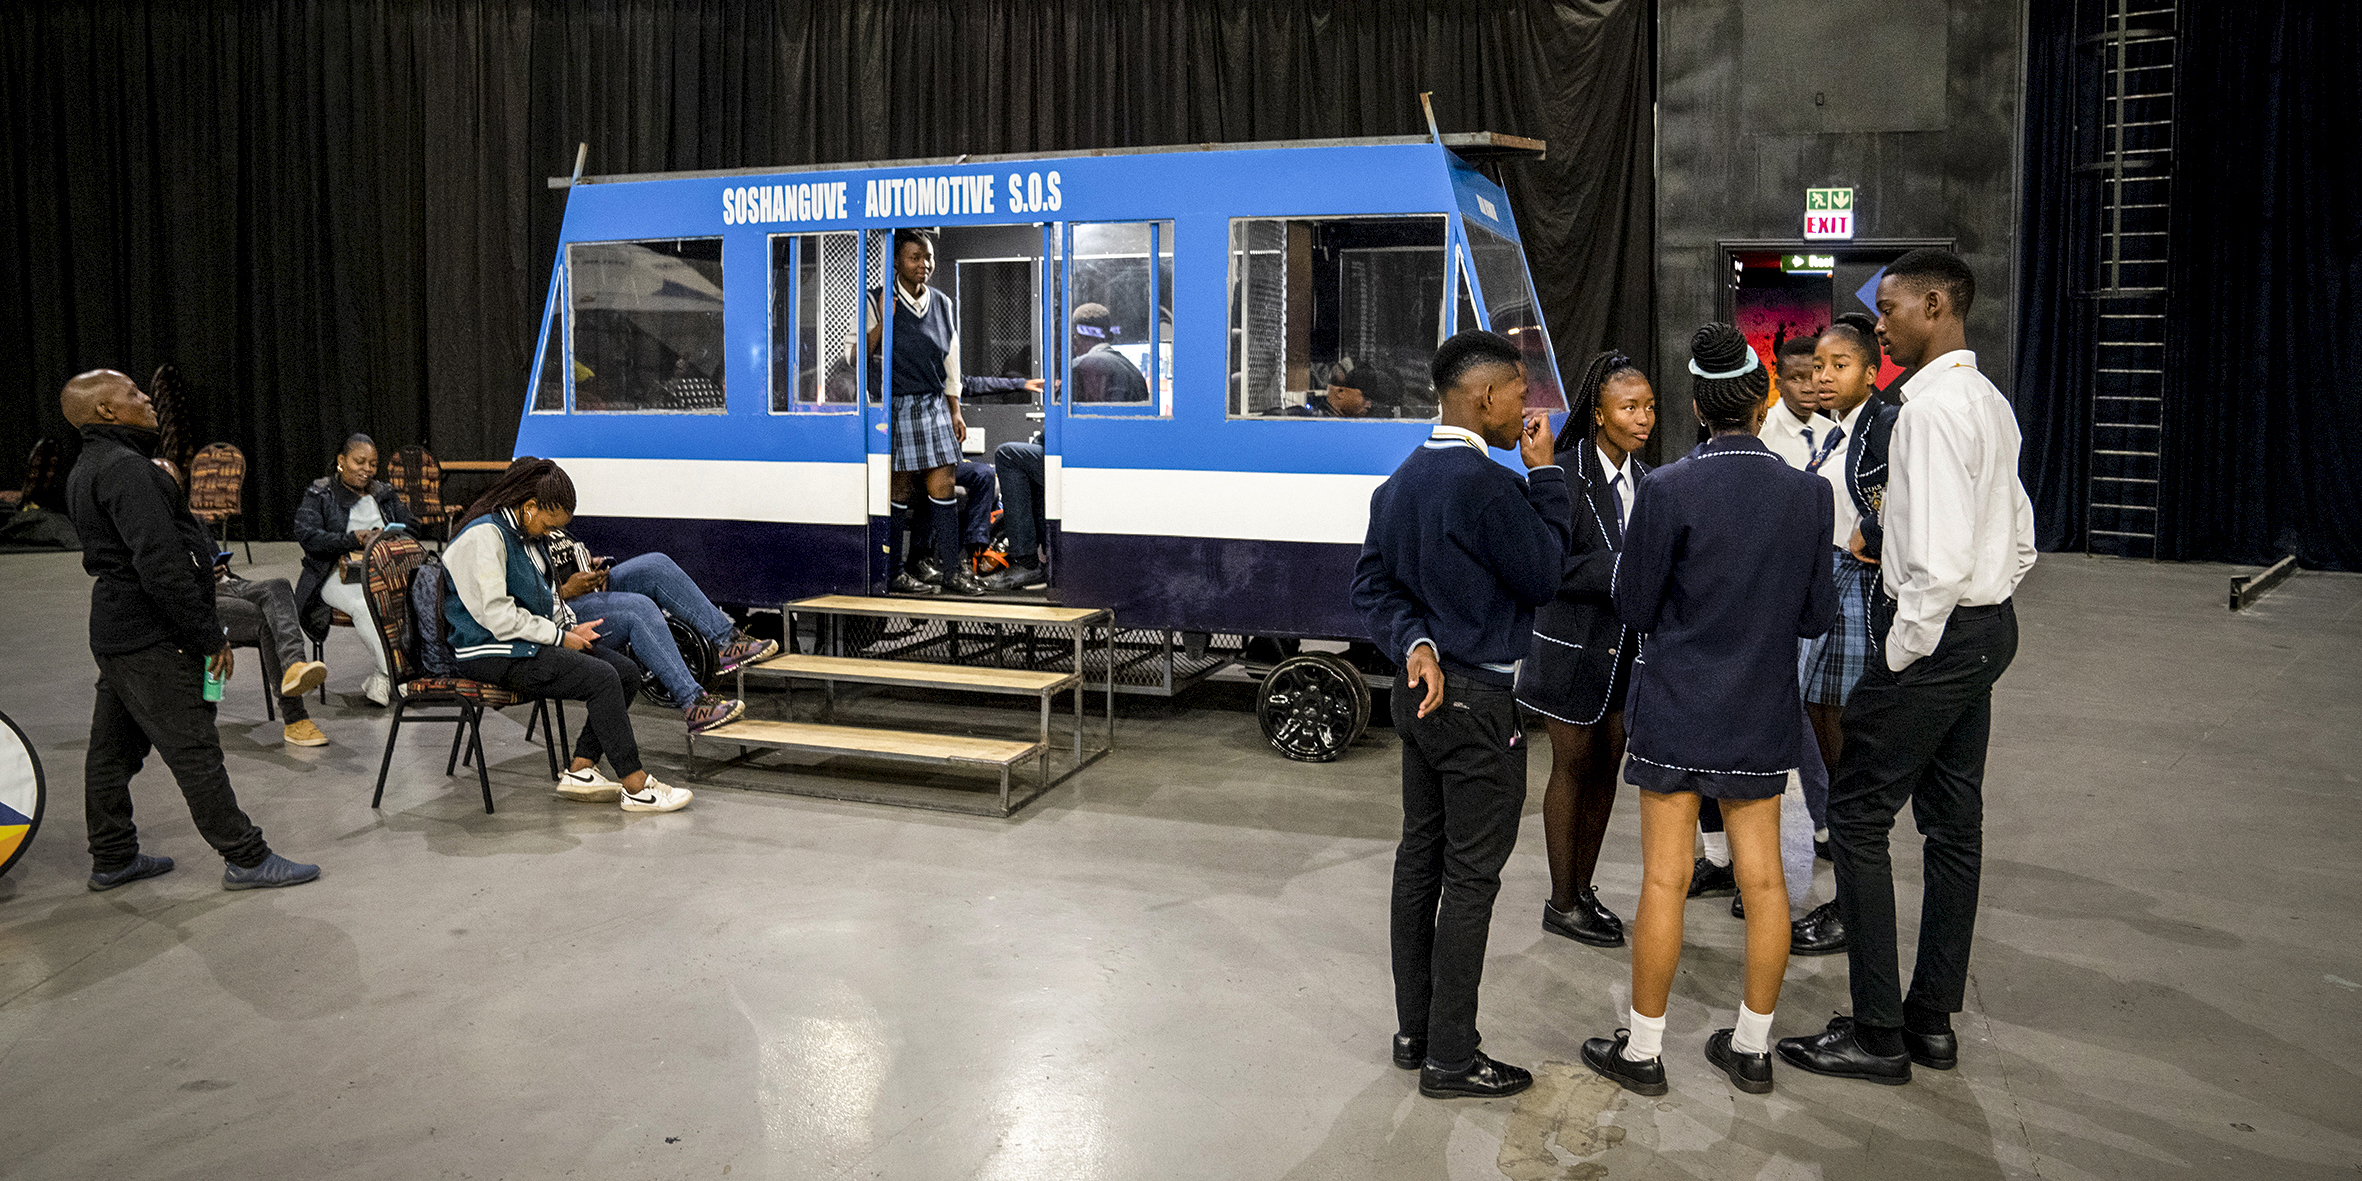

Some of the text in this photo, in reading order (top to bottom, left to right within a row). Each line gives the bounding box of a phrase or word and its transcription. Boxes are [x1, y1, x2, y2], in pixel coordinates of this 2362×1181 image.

[723, 170, 1062, 225] SOSHANGUVE AUTOMOTIVE S.O.S
[1807, 217, 1848, 234] EXIT
